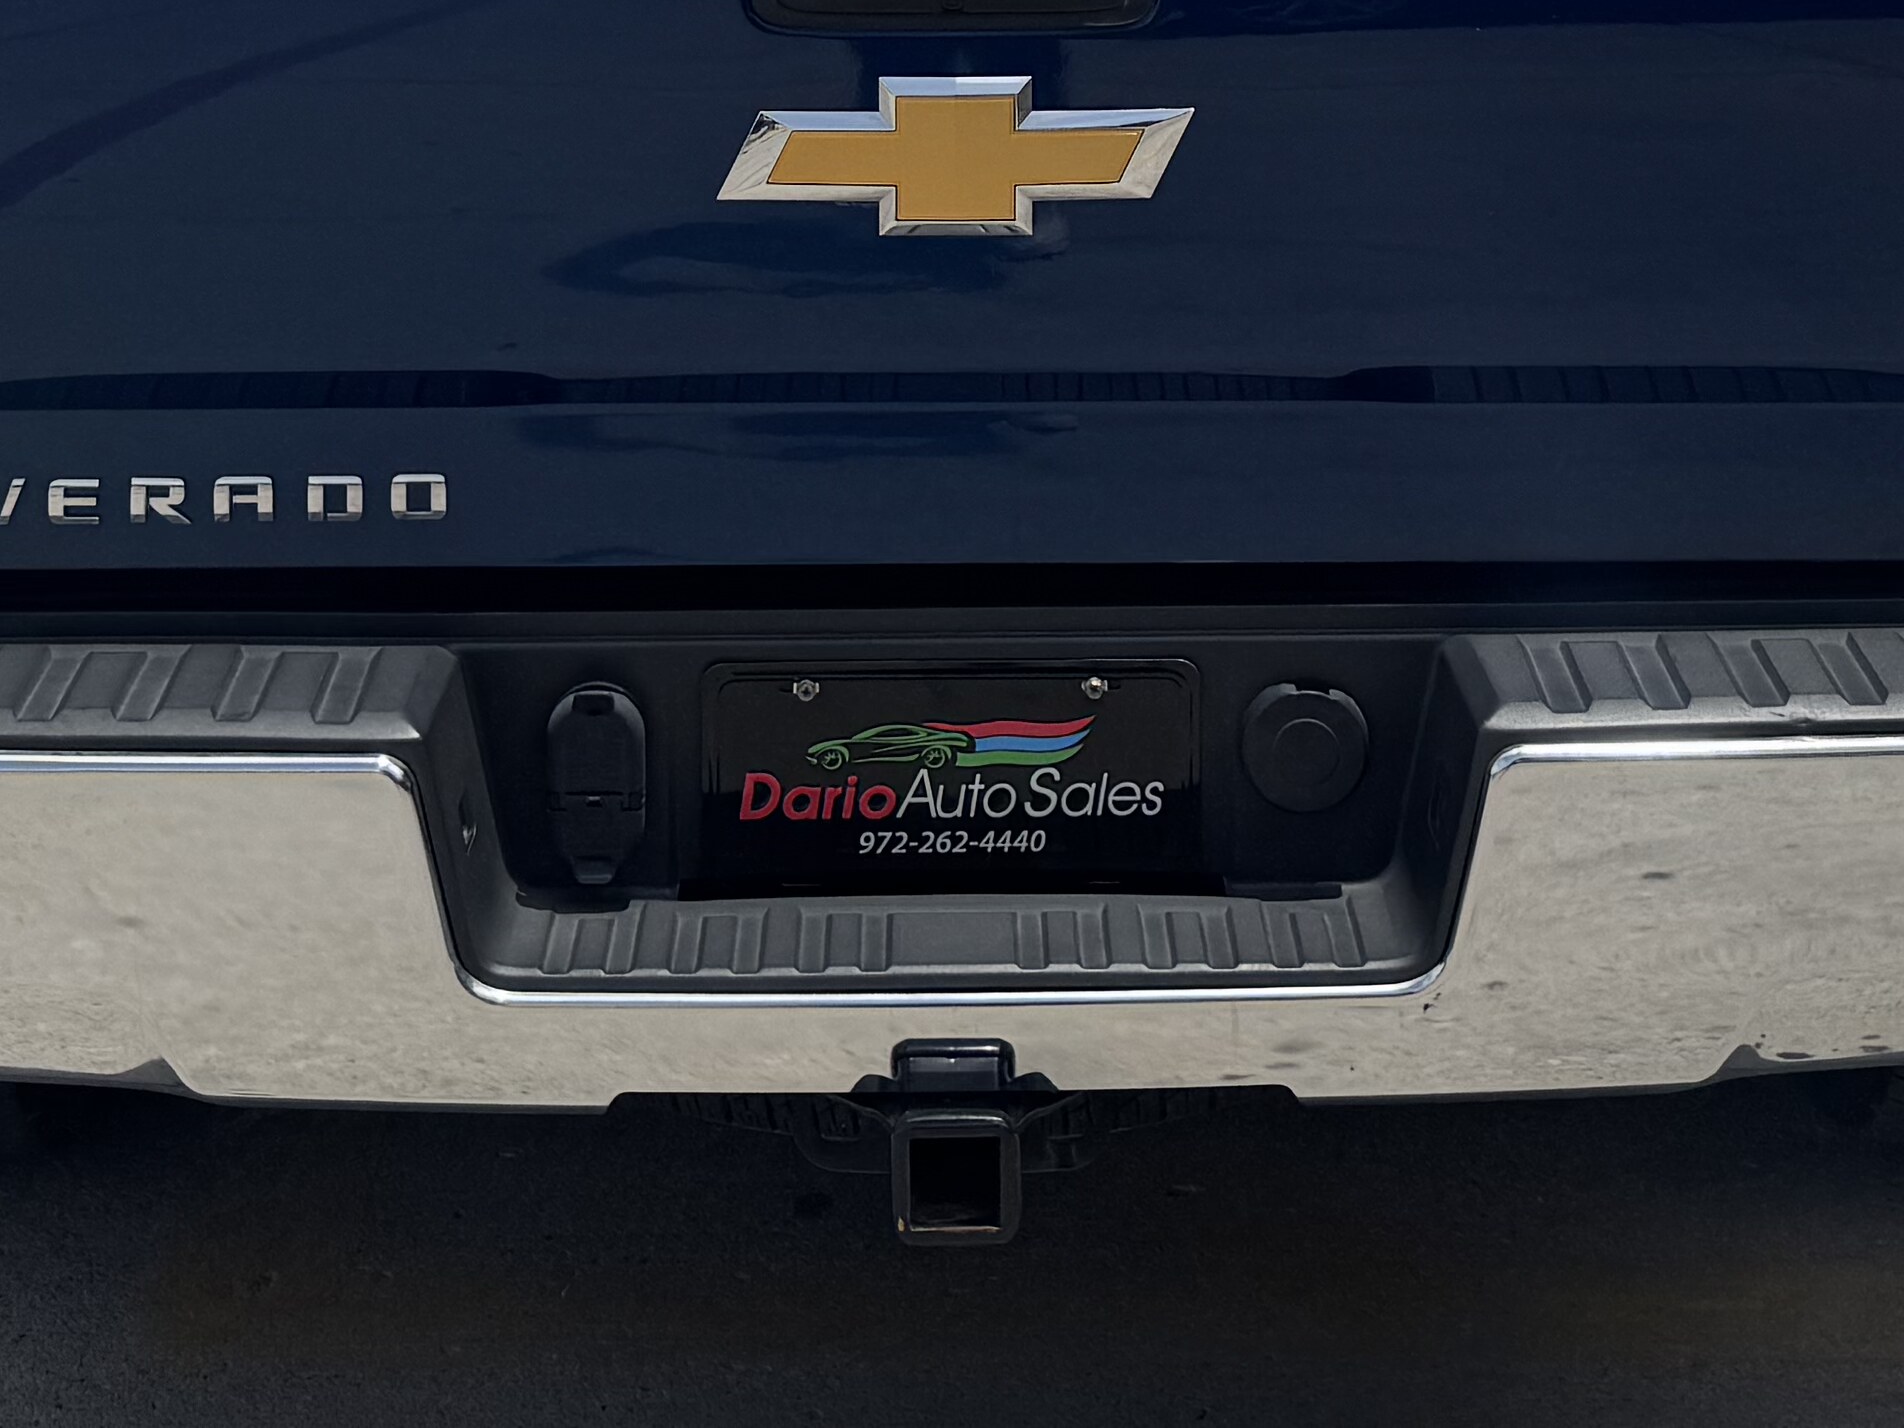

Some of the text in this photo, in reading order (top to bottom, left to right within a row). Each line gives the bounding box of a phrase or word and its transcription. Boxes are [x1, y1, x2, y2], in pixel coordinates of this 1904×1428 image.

[739, 767, 1164, 821] Dario Auto Sales
[858, 829, 1047, 855] 972-262-4440
